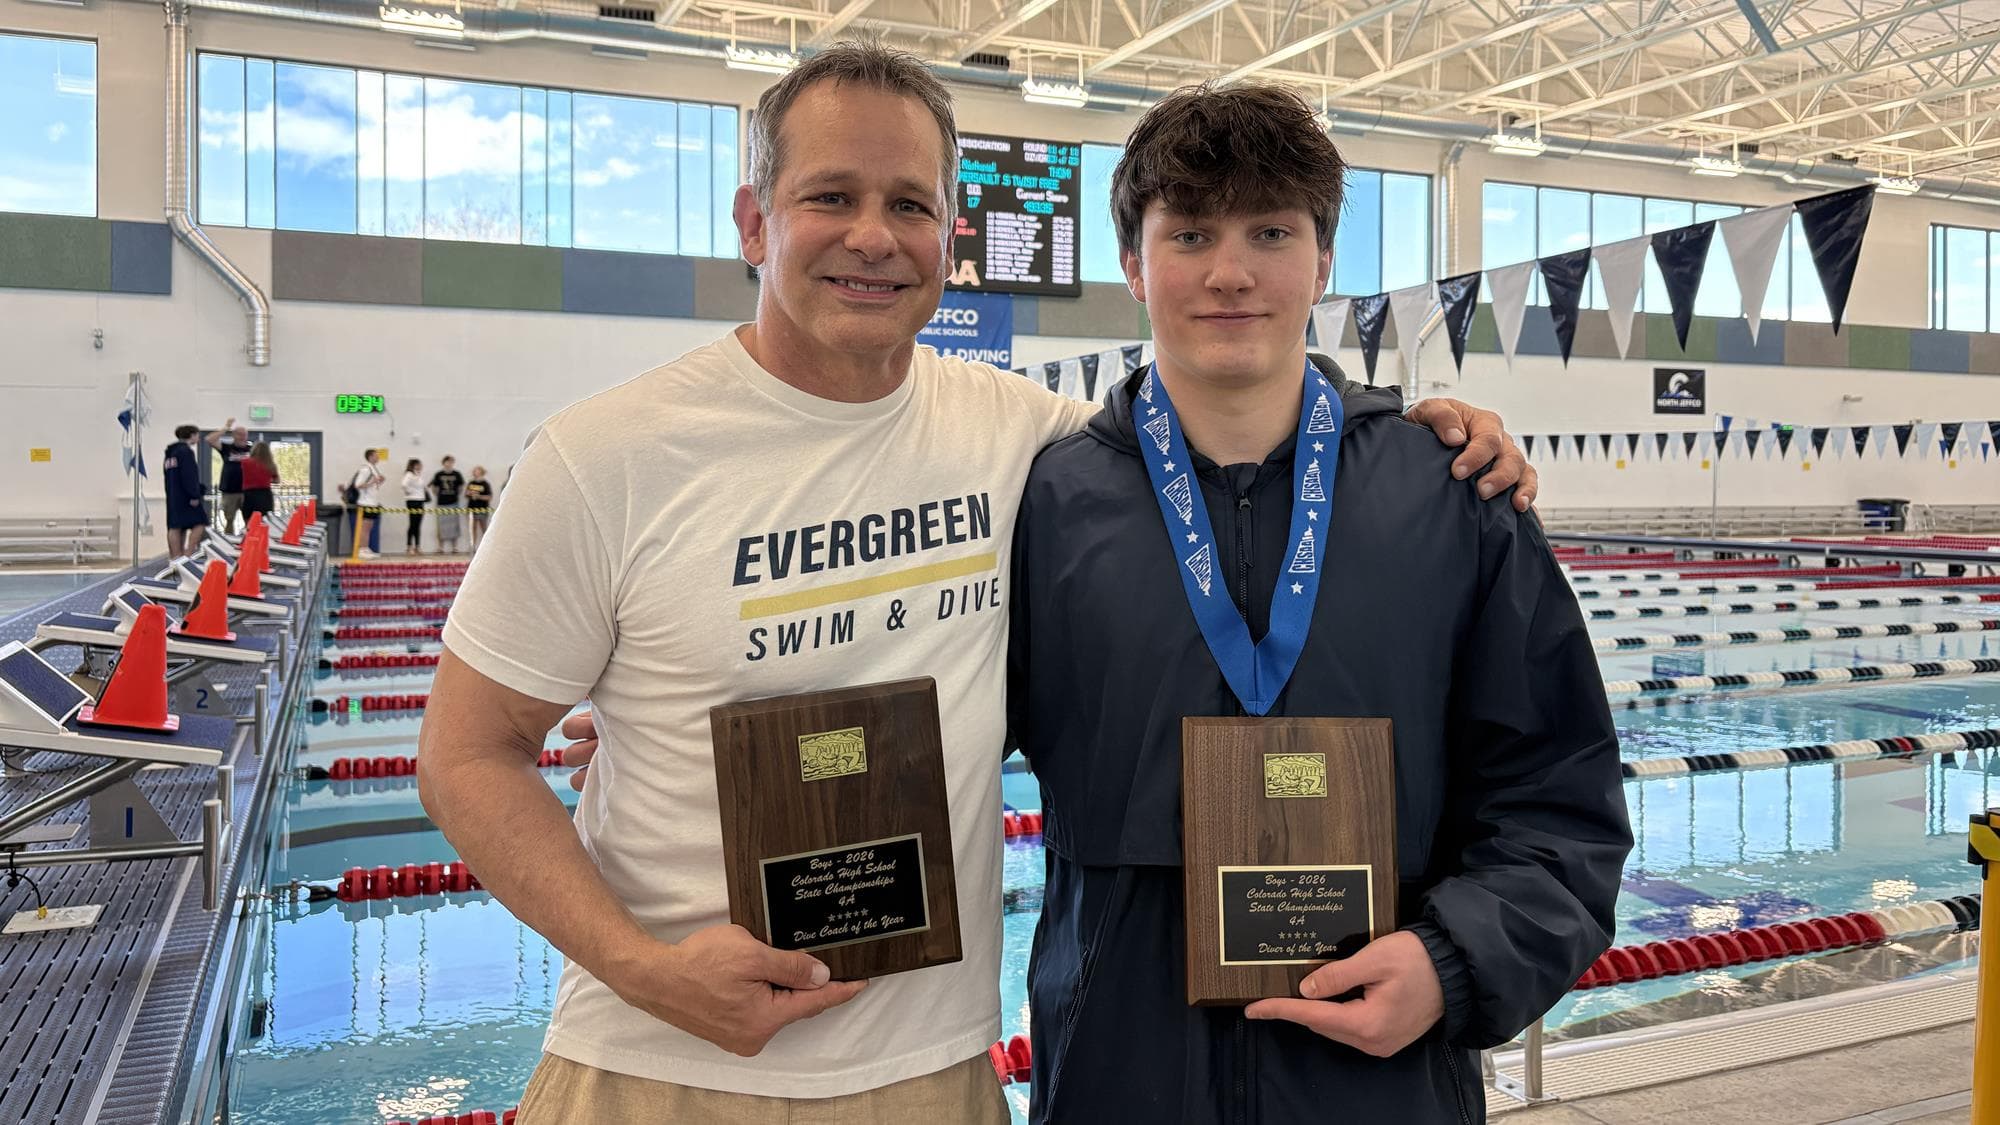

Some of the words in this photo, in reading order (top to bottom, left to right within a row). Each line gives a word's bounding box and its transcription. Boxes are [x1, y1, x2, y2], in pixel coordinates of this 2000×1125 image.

[962, 158, 996, 172] National
[1012, 175, 1038, 188] TWIST
[1016, 188, 1045, 200] Current
[1046, 190, 1069, 203] Score
[942, 328, 978, 337] SCHOOLS
[956, 349, 1010, 363] DIVING
[336, 394, 384, 413] 09:34
[732, 493, 991, 586] EVERGREEN
[1292, 539, 1314, 572] CHSAA
[746, 610, 854, 661] SWIM
[886, 599, 907, 631] &
[938, 577, 1000, 620] DIVE
[196, 689, 209, 709] 2
[125, 807, 133, 838] 1
[810, 858, 833, 870] Boys
[846, 850, 874, 864] 2026
[792, 873, 834, 887] Colorado
[837, 865, 862, 879] High
[864, 859, 896, 874] School
[1264, 874, 1286, 886] Boys
[1298, 874, 1326, 885] 2026
[794, 888, 822, 900] State
[824, 876, 894, 895] Championships
[1246, 888, 1286, 899] Colorado
[1290, 888, 1312, 901] High
[1316, 888, 1346, 898] School
[838, 894, 856, 906] 4A
[1248, 902, 1274, 912] State
[1278, 901, 1344, 914] Championships
[794, 930, 816, 942] Dive
[820, 922, 848, 938] Coach
[851, 920, 862, 934] of
[864, 918, 878, 929] the
[880, 914, 904, 928] Year
[1289, 915, 1305, 926] 4A
[1258, 942, 1284, 954] Diver
[1286, 943, 1296, 956] of
[1298, 942, 1312, 953] the
[1314, 941, 1338, 956] Year
